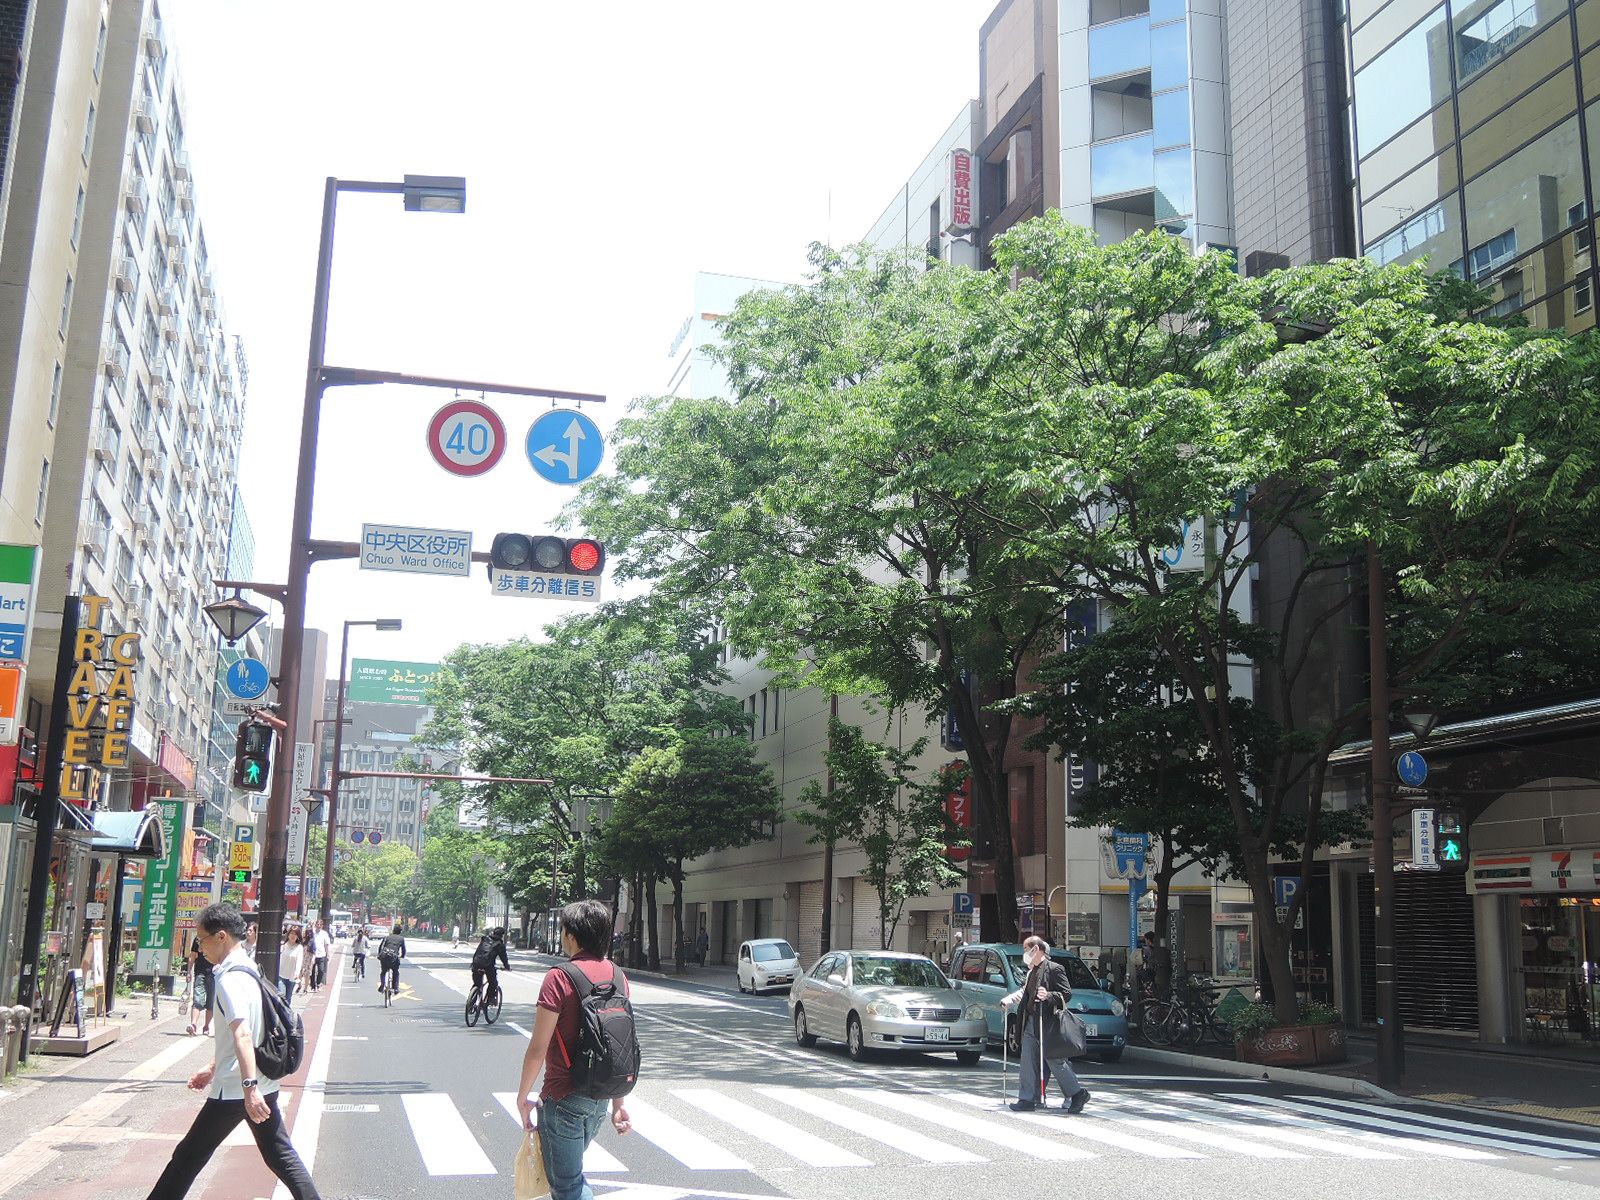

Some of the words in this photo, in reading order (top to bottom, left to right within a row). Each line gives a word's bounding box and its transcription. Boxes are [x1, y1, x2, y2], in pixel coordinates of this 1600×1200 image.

[953, 153, 971, 225] 自費出版
[446, 422, 488, 455] 40
[365, 531, 468, 557] 中央区役所
[366, 553, 394, 565] Chuo
[400, 555, 427, 567] Ward
[432, 557, 464, 570] Office
[497, 574, 596, 597] 歩車分離信号
[0, 598, 26, 611] art
[60, 595, 111, 798] TRAVEL
[103, 633, 141, 766] CAFE
[238, 826, 251, 841] P
[1116, 845, 1143, 853] クリニック
[234, 870, 246, 882] 空
[1282, 879, 1297, 903] P
[959, 895, 970, 911] P
